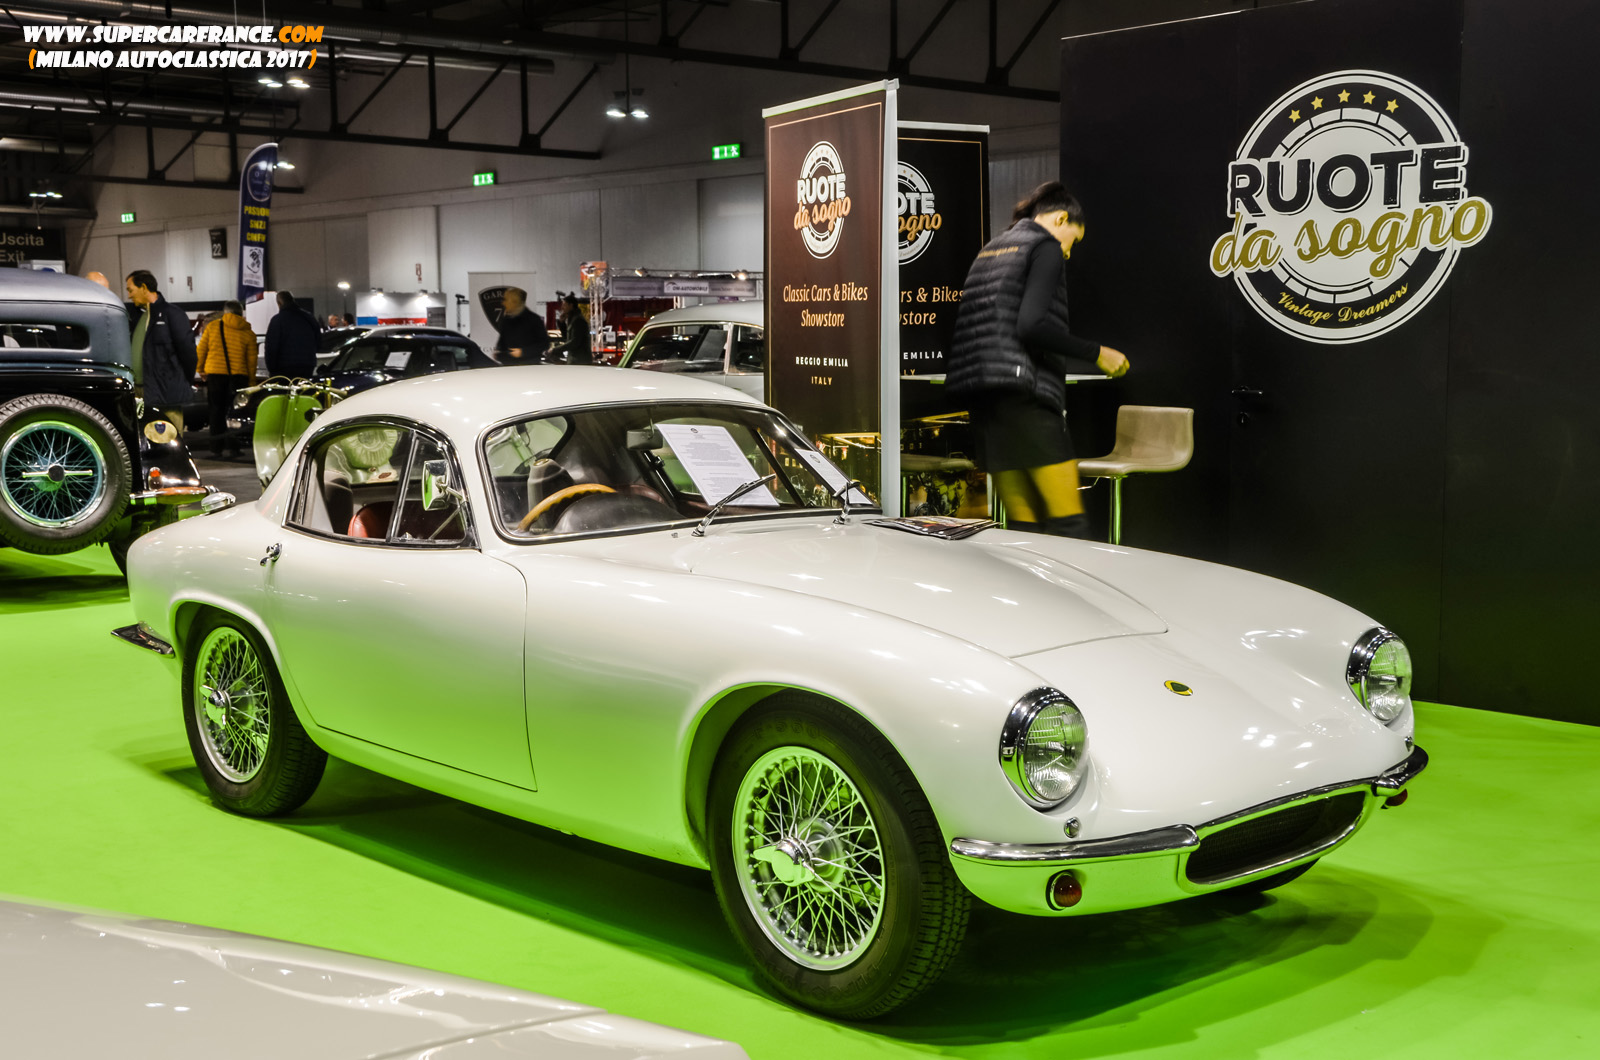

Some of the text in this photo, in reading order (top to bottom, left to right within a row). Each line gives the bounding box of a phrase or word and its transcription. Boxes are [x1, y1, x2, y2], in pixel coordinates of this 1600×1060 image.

[797, 172, 847, 205] RUOTE
[1229, 144, 1467, 215] RUOTE
[794, 196, 851, 232] da sogno
[898, 192, 935, 216] OTE
[898, 213, 942, 241] ogno
[1211, 199, 1487, 279] da sogno
[783, 282, 868, 302] Classic Cars & Bikes
[900, 290, 913, 303] rs
[916, 287, 928, 303] &
[1278, 283, 1408, 325] Vintage Dreamers
[801, 309, 845, 327] Showstore
[900, 311, 937, 325] store
[795, 356, 849, 368] REGGIO EMILIA
[903, 351, 943, 360] EMILIA
[811, 376, 833, 386] ITALY
